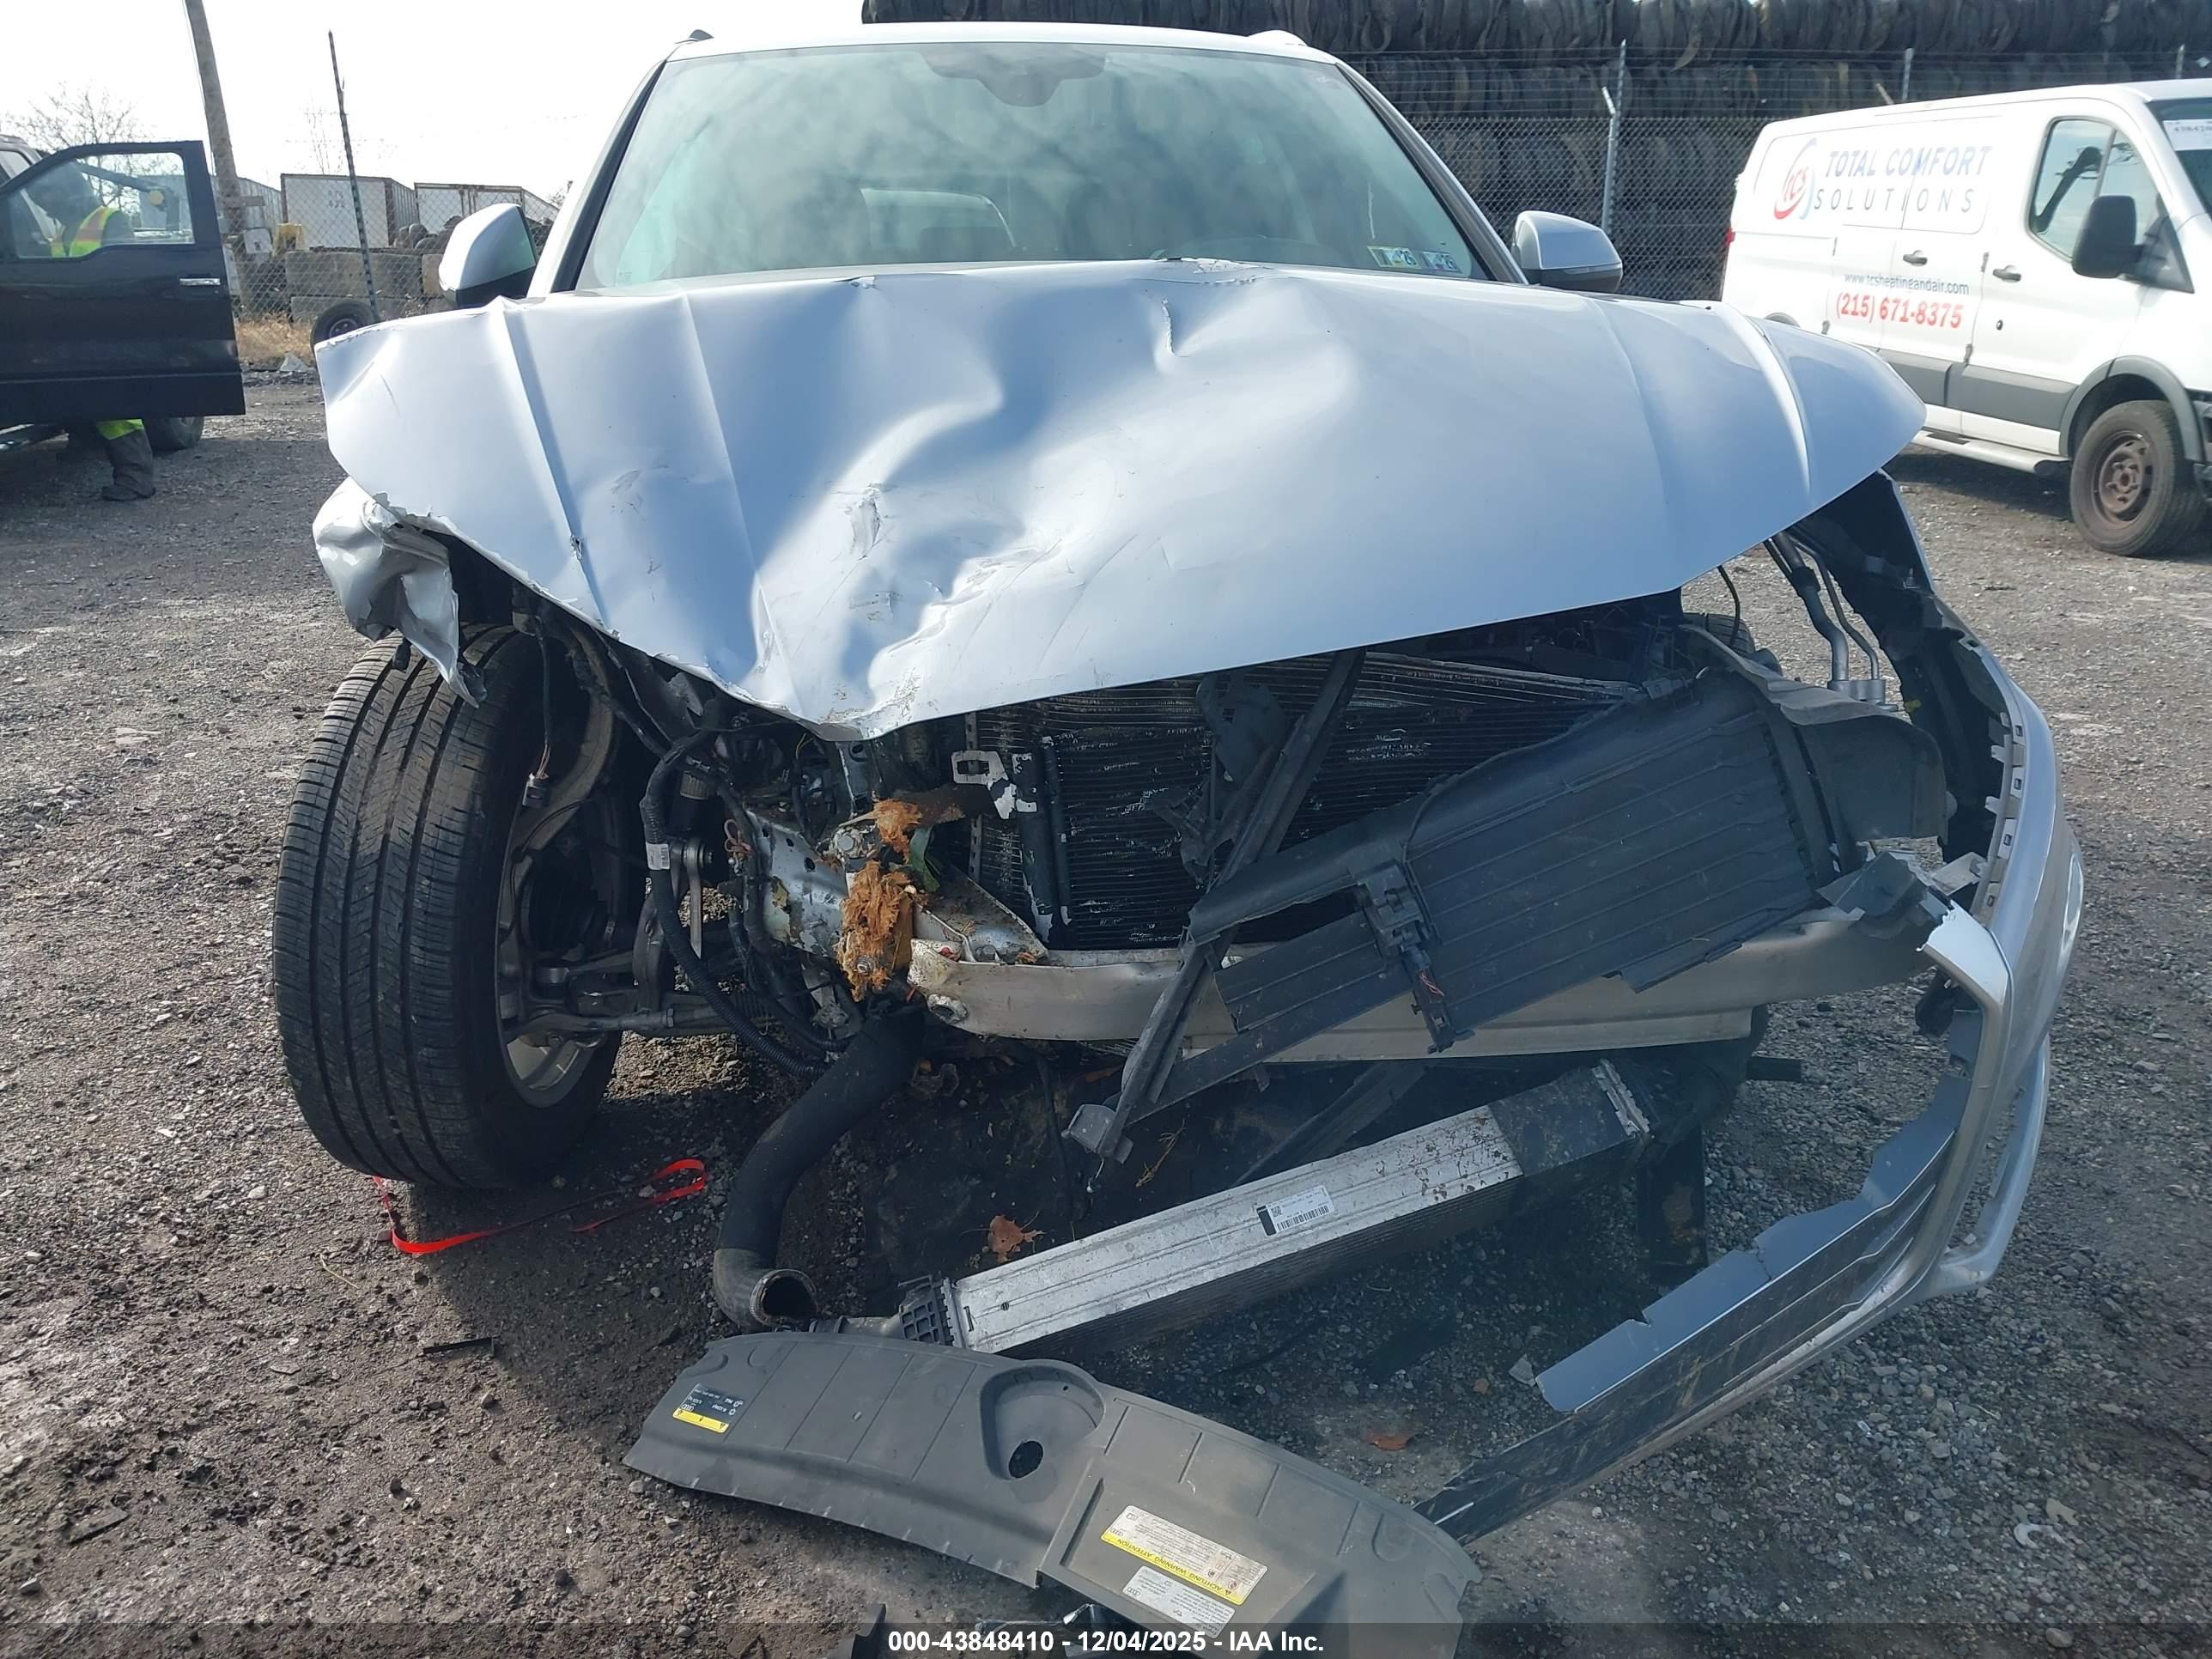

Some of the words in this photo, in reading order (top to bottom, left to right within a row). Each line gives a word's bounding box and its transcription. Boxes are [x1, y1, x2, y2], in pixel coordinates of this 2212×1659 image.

[1826, 149, 1877, 177] TOTAL
[1886, 147, 1992, 177] COMFORT
[1814, 188, 1974, 213] SOLUTIONS
[1836, 292, 1875, 323] (215)
[1879, 295, 1965, 328] 671-8375
[1117, 1539, 1152, 1558] ATTENTION
[1154, 1556, 1188, 1574] WARNING
[1189, 1572, 1223, 1591] ACHTUNG
